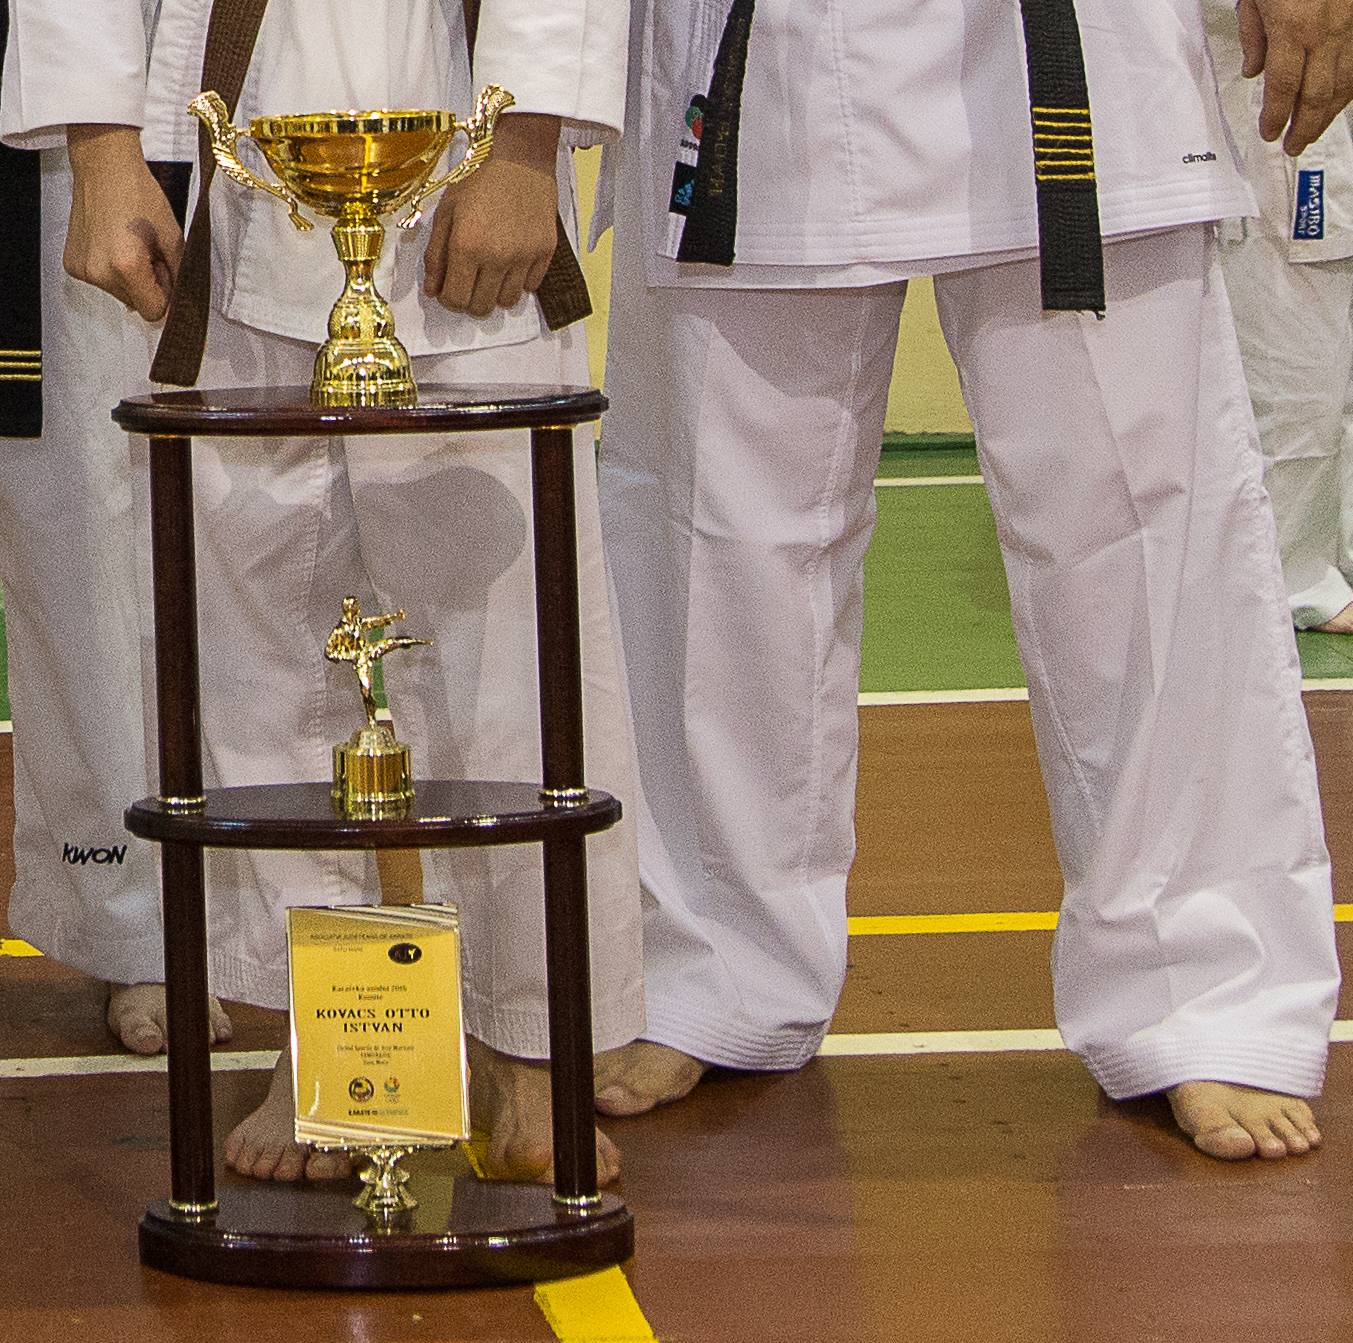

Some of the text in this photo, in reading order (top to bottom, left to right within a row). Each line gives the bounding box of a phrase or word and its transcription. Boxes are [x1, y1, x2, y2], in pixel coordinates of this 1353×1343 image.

[1306, 174, 1322, 237] MASIBO
[61, 842, 128, 866] KWON
[315, 1008, 431, 1020] KOVACS OTTO
[343, 1022, 404, 1034] ISTVAN
